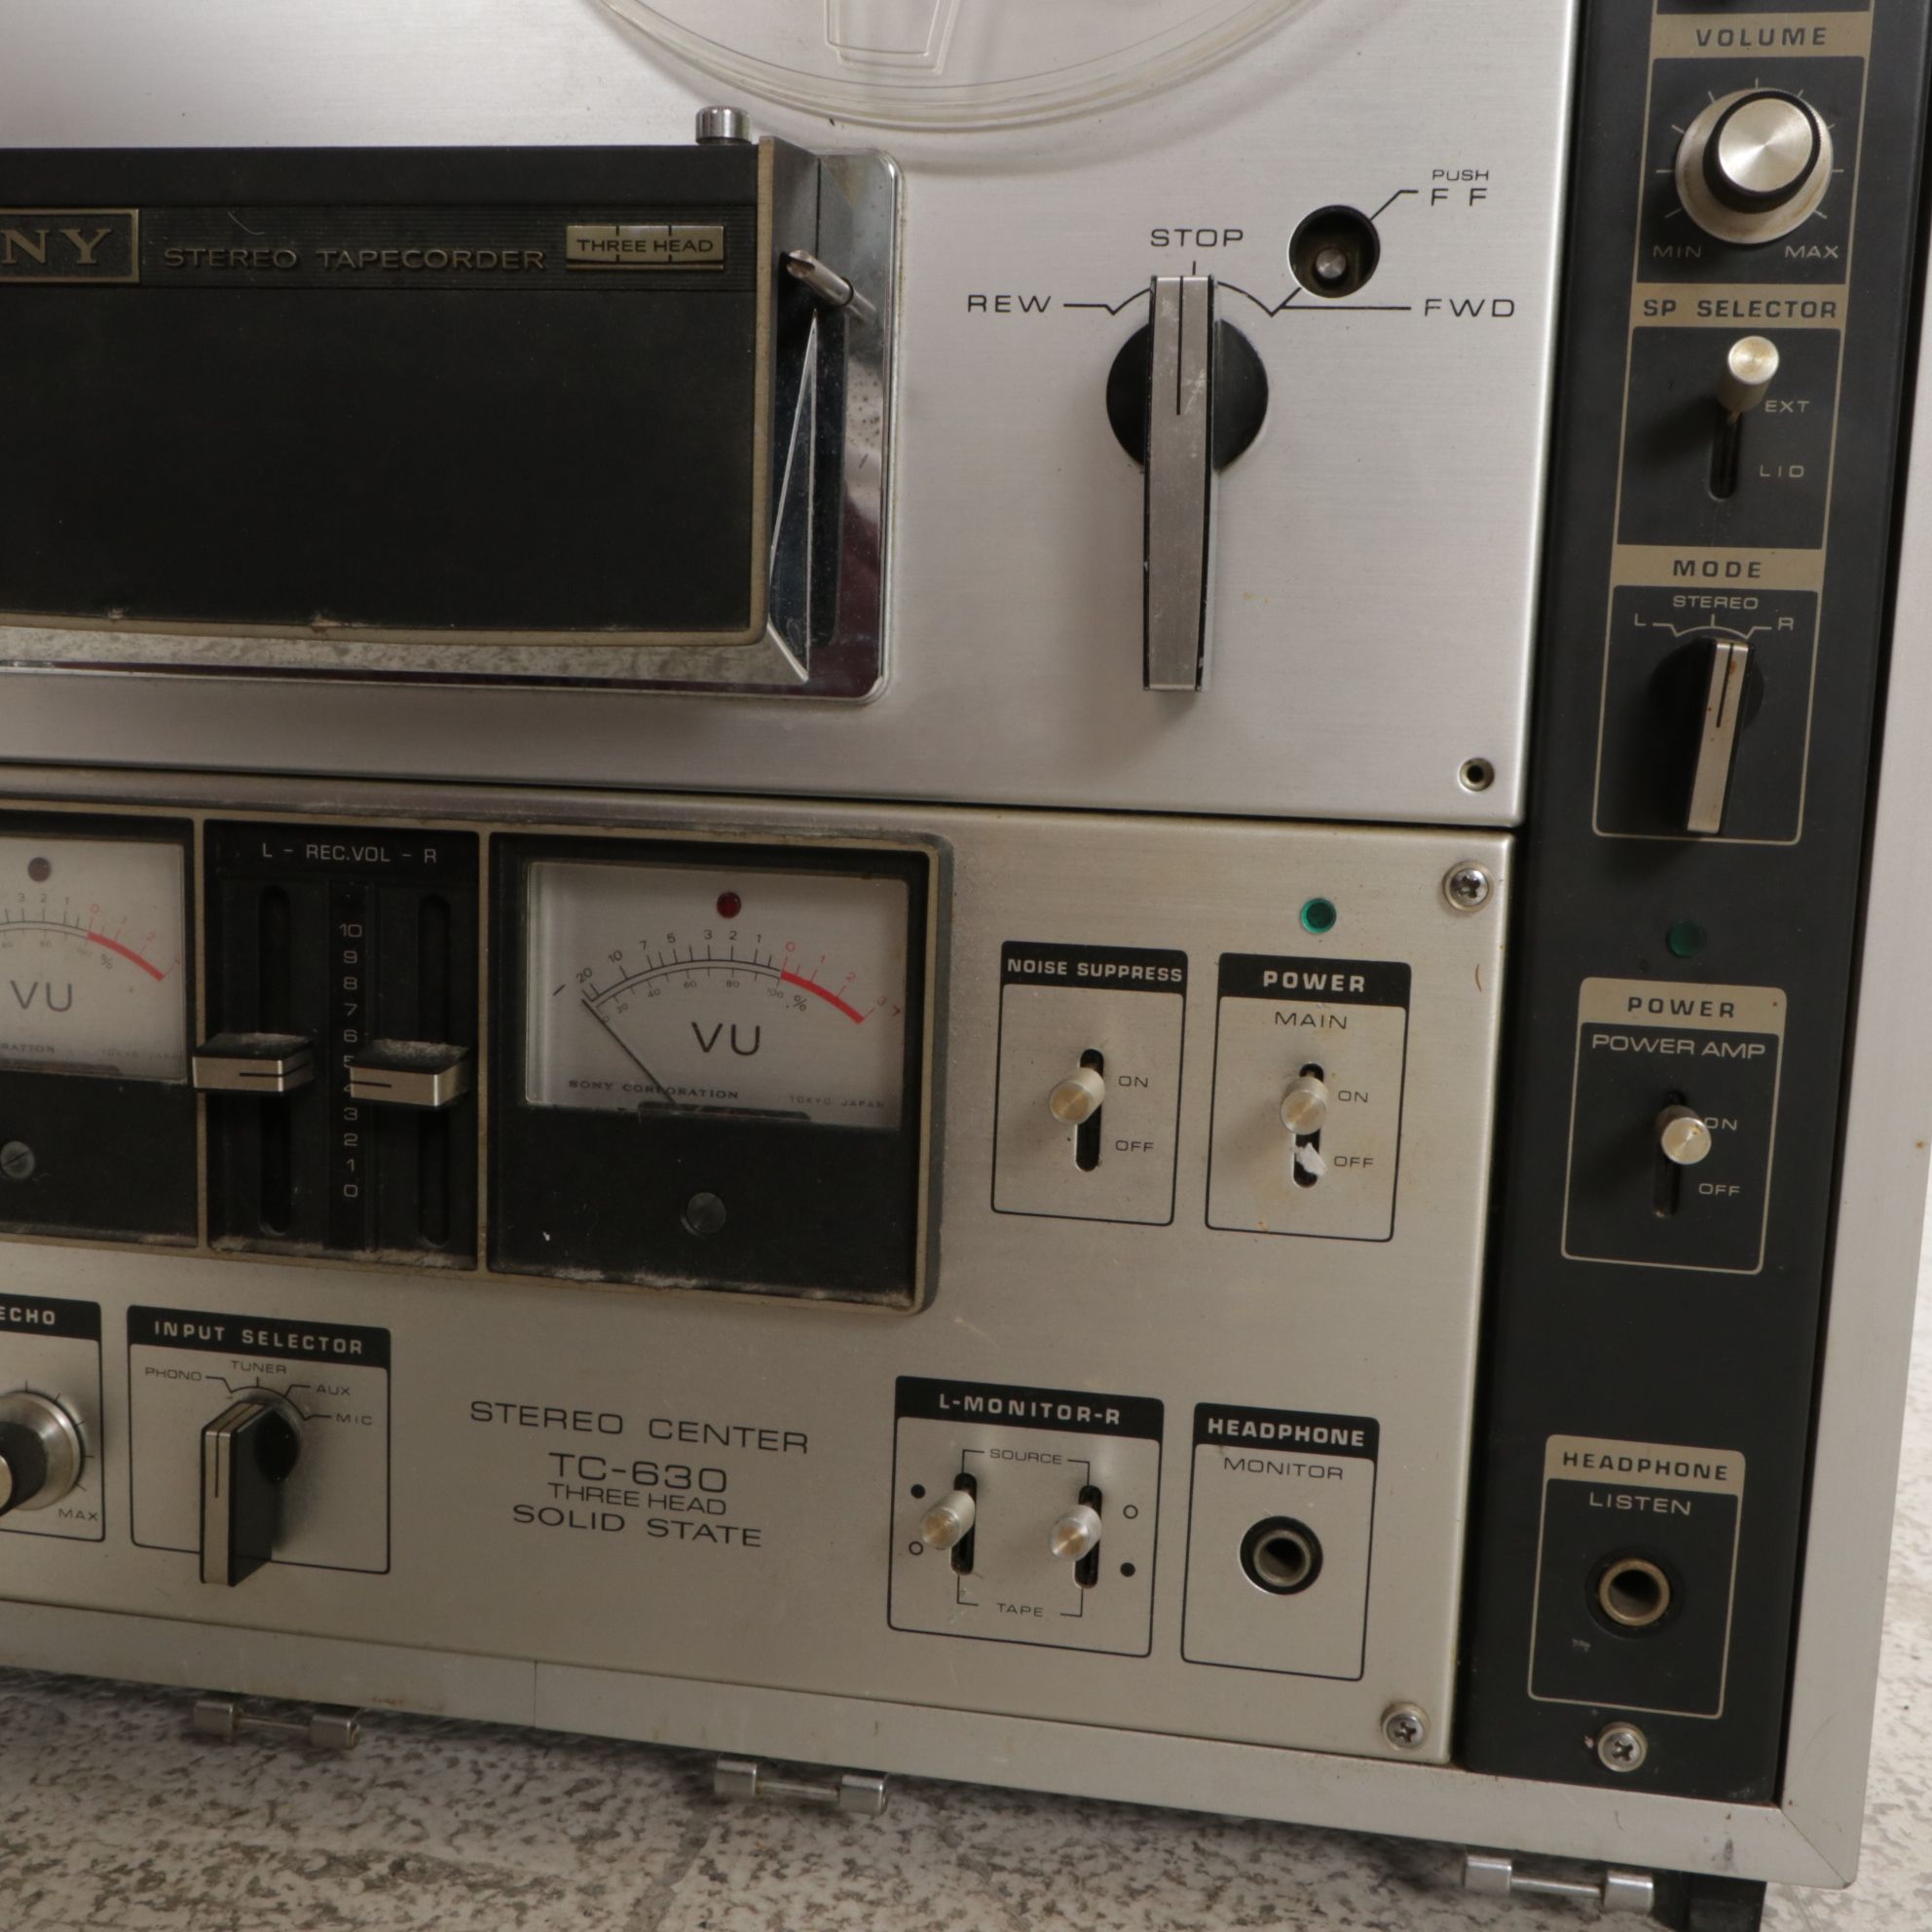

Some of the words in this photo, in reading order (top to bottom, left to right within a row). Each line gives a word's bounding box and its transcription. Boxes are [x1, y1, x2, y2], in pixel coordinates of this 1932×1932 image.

[1695, 26, 1828, 48] VOLUME
[1431, 169, 1490, 182] PUSH
[576, 239, 647, 253] THREE
[653, 240, 714, 253] HEAD
[1150, 229, 1245, 248] STOP
[164, 247, 298, 269] STEREO
[316, 249, 545, 271] TAPECORDER
[1653, 245, 1702, 259] MIN
[1784, 245, 1839, 259] MAX
[967, 294, 1052, 314] REW
[1424, 298, 1516, 318] FWD
[1643, 299, 1677, 317] SP
[1696, 300, 1838, 319] SELECTOR
[1765, 399, 1810, 414] EXT
[1672, 559, 1763, 579] MODE
[1672, 595, 1760, 610] STEREO
[1634, 613, 1647, 627] L
[1777, 617, 1795, 631] R
[262, 843, 273, 858] L
[306, 844, 390, 863] REC.VOL
[424, 848, 437, 864] R
[339, 923, 363, 939] 10
[343, 949, 358, 965] 9
[576, 967, 593, 985] 20
[608, 949, 624, 964] 10
[639, 940, 648, 950] 7
[666, 932, 677, 944] 5
[703, 929, 713, 940] 3
[728, 930, 738, 941] 2
[786, 942, 796, 952] 0
[1007, 957, 1068, 976] NOISE
[1076, 962, 1183, 983] SUPPRESS
[343, 976, 358, 991] 8
[1262, 970, 1365, 993] POWER
[10, 980, 73, 1013] VU
[343, 1002, 358, 1018] 7
[1627, 996, 1735, 1019] POWER
[1275, 1011, 1348, 1030] MAIN
[343, 1028, 358, 1044] 6
[690, 1021, 762, 1057] VU
[1591, 1033, 1695, 1056] POWER
[1700, 1041, 1766, 1059] AMP
[568, 1079, 613, 1091] SONY
[622, 1083, 739, 1100] CORPORATION
[1118, 1075, 1149, 1089] ON
[789, 1095, 833, 1106] TOKYO
[841, 1098, 886, 1109] JAPAN
[1338, 1090, 1369, 1103] ON
[343, 1106, 358, 1122] 3
[1703, 1117, 1738, 1132] ON
[343, 1133, 358, 1147] 2
[1115, 1139, 1155, 1154] OFF
[346, 1159, 355, 1172] 1
[1333, 1155, 1374, 1169] OFF
[343, 1184, 359, 1199] 0
[1697, 1182, 1741, 1198] OFF
[154, 1320, 226, 1342] INPUT
[242, 1329, 363, 1355] SELECTOR
[144, 1366, 203, 1382] PHONO
[231, 1359, 287, 1375] TUNER
[316, 1384, 352, 1396] AUX
[939, 1393, 1121, 1426] L-MONITOR-R
[336, 1414, 373, 1427] MIC
[470, 1400, 624, 1434] STEREO
[649, 1418, 809, 1455] CENTER
[1208, 1417, 1365, 1448] HEADPHONE
[989, 1447, 1062, 1466] SOURCE
[548, 1452, 727, 1494] TC-630
[1224, 1457, 1344, 1481] MONITOR
[1562, 1451, 1728, 1481] HEADPHONE
[547, 1482, 640, 1507] THREE
[648, 1493, 726, 1515] HEAD
[1588, 1491, 1691, 1516] LISTEN
[58, 1508, 98, 1522] MAX
[513, 1504, 625, 1532] SOLID
[647, 1518, 762, 1548] STATE
[996, 1602, 1044, 1617] TAPE
